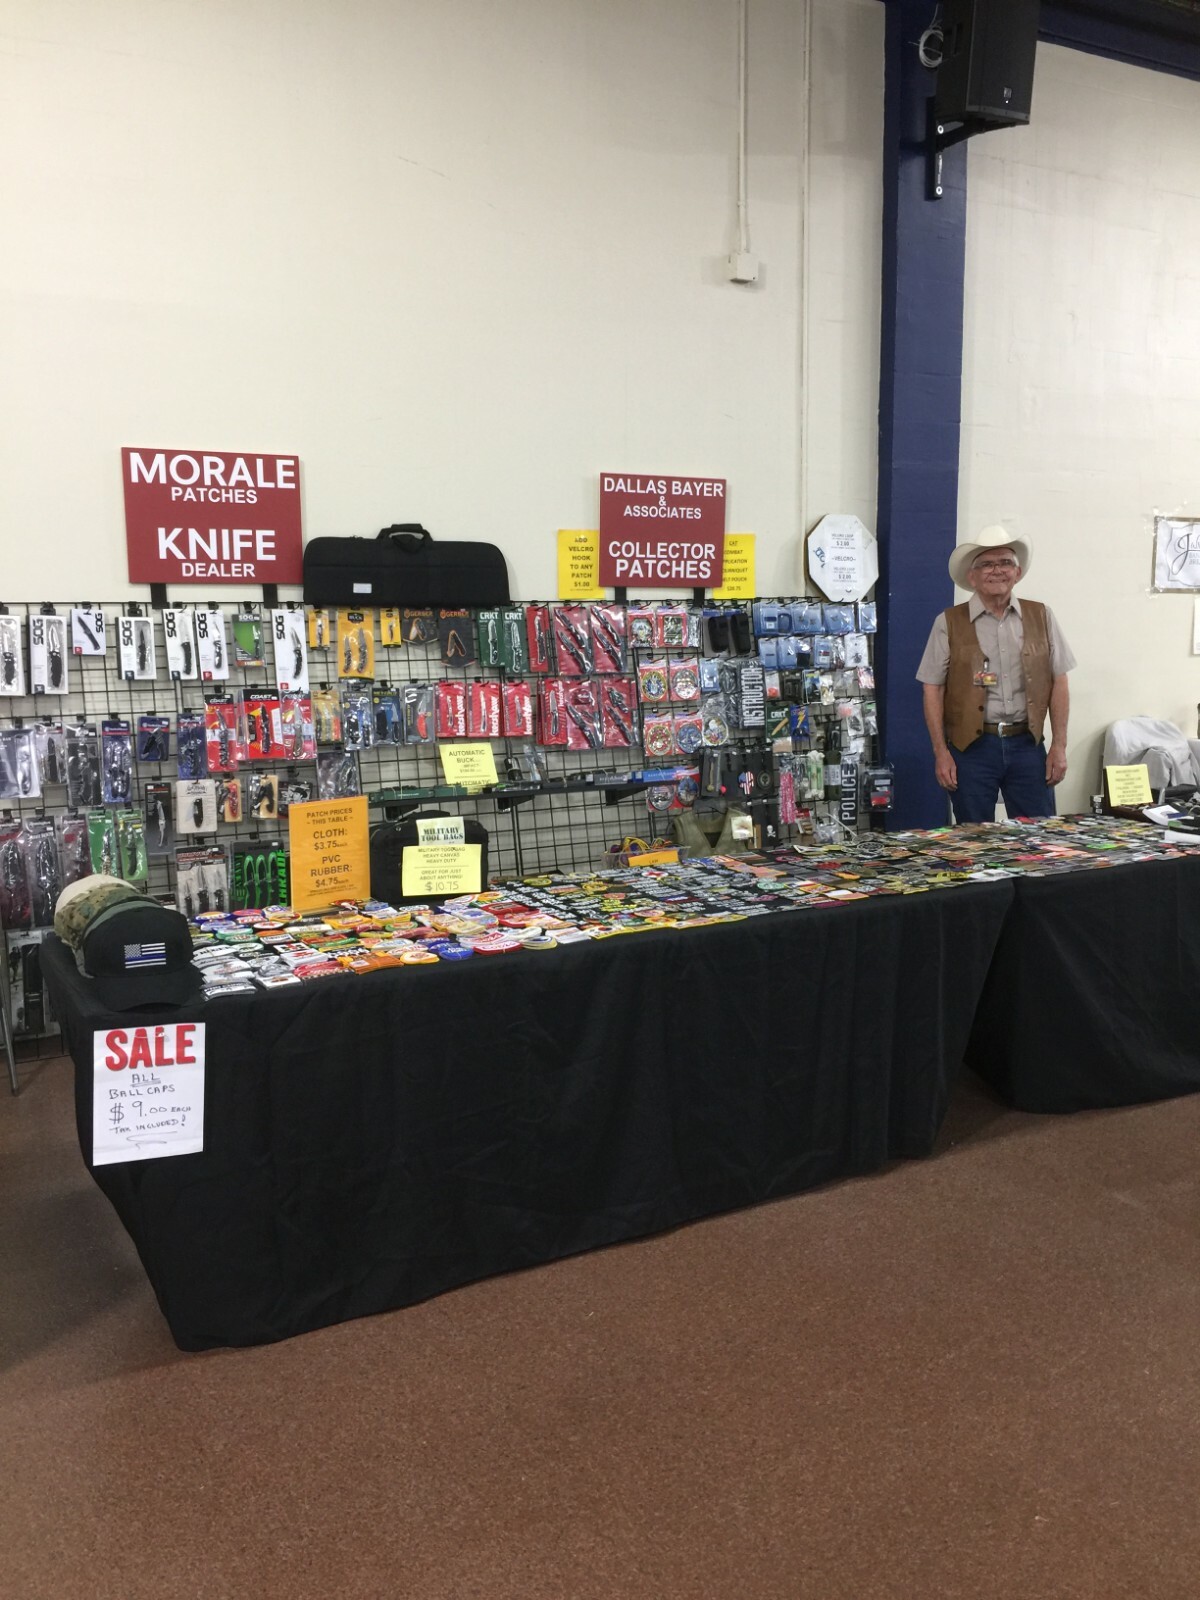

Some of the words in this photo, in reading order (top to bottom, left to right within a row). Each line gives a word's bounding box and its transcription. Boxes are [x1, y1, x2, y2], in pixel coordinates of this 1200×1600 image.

[129, 452, 296, 489] MORALE
[171, 486, 258, 504] PATCHES
[604, 477, 668, 495] DALLAS
[671, 481, 724, 498] BAYER
[658, 495, 667, 507] &
[623, 505, 702, 520] ASSOCIATES
[157, 527, 276, 561] KNIFE
[608, 541, 716, 559] COLLECTOR
[181, 562, 256, 577] DEALER
[615, 560, 712, 579] PATCHES
[95, 613, 104, 633] SOG
[165, 612, 177, 638] SOG
[480, 612, 499, 620] CRKT
[505, 612, 523, 620] CRKT
[32, 619, 44, 645] SOG
[121, 620, 133, 646] SOG
[197, 613, 209, 639] SOG
[275, 615, 286, 640] SOG
[741, 667, 766, 727] INSTRUCTOR
[841, 766, 856, 821] POLICE
[307, 810, 328, 818] PATCH
[330, 808, 353, 816] PRICES
[313, 828, 348, 839] CLOTH:
[423, 827, 459, 835] MILITARY
[443, 833, 464, 841] BAGS
[322, 855, 341, 864] PVC
[311, 864, 353, 877] RUBBER:
[105, 1024, 196, 1072] SALE
[131, 1073, 161, 1084] ALL
[109, 1089, 143, 1100] BALL
[147, 1084, 176, 1095] CAPS
